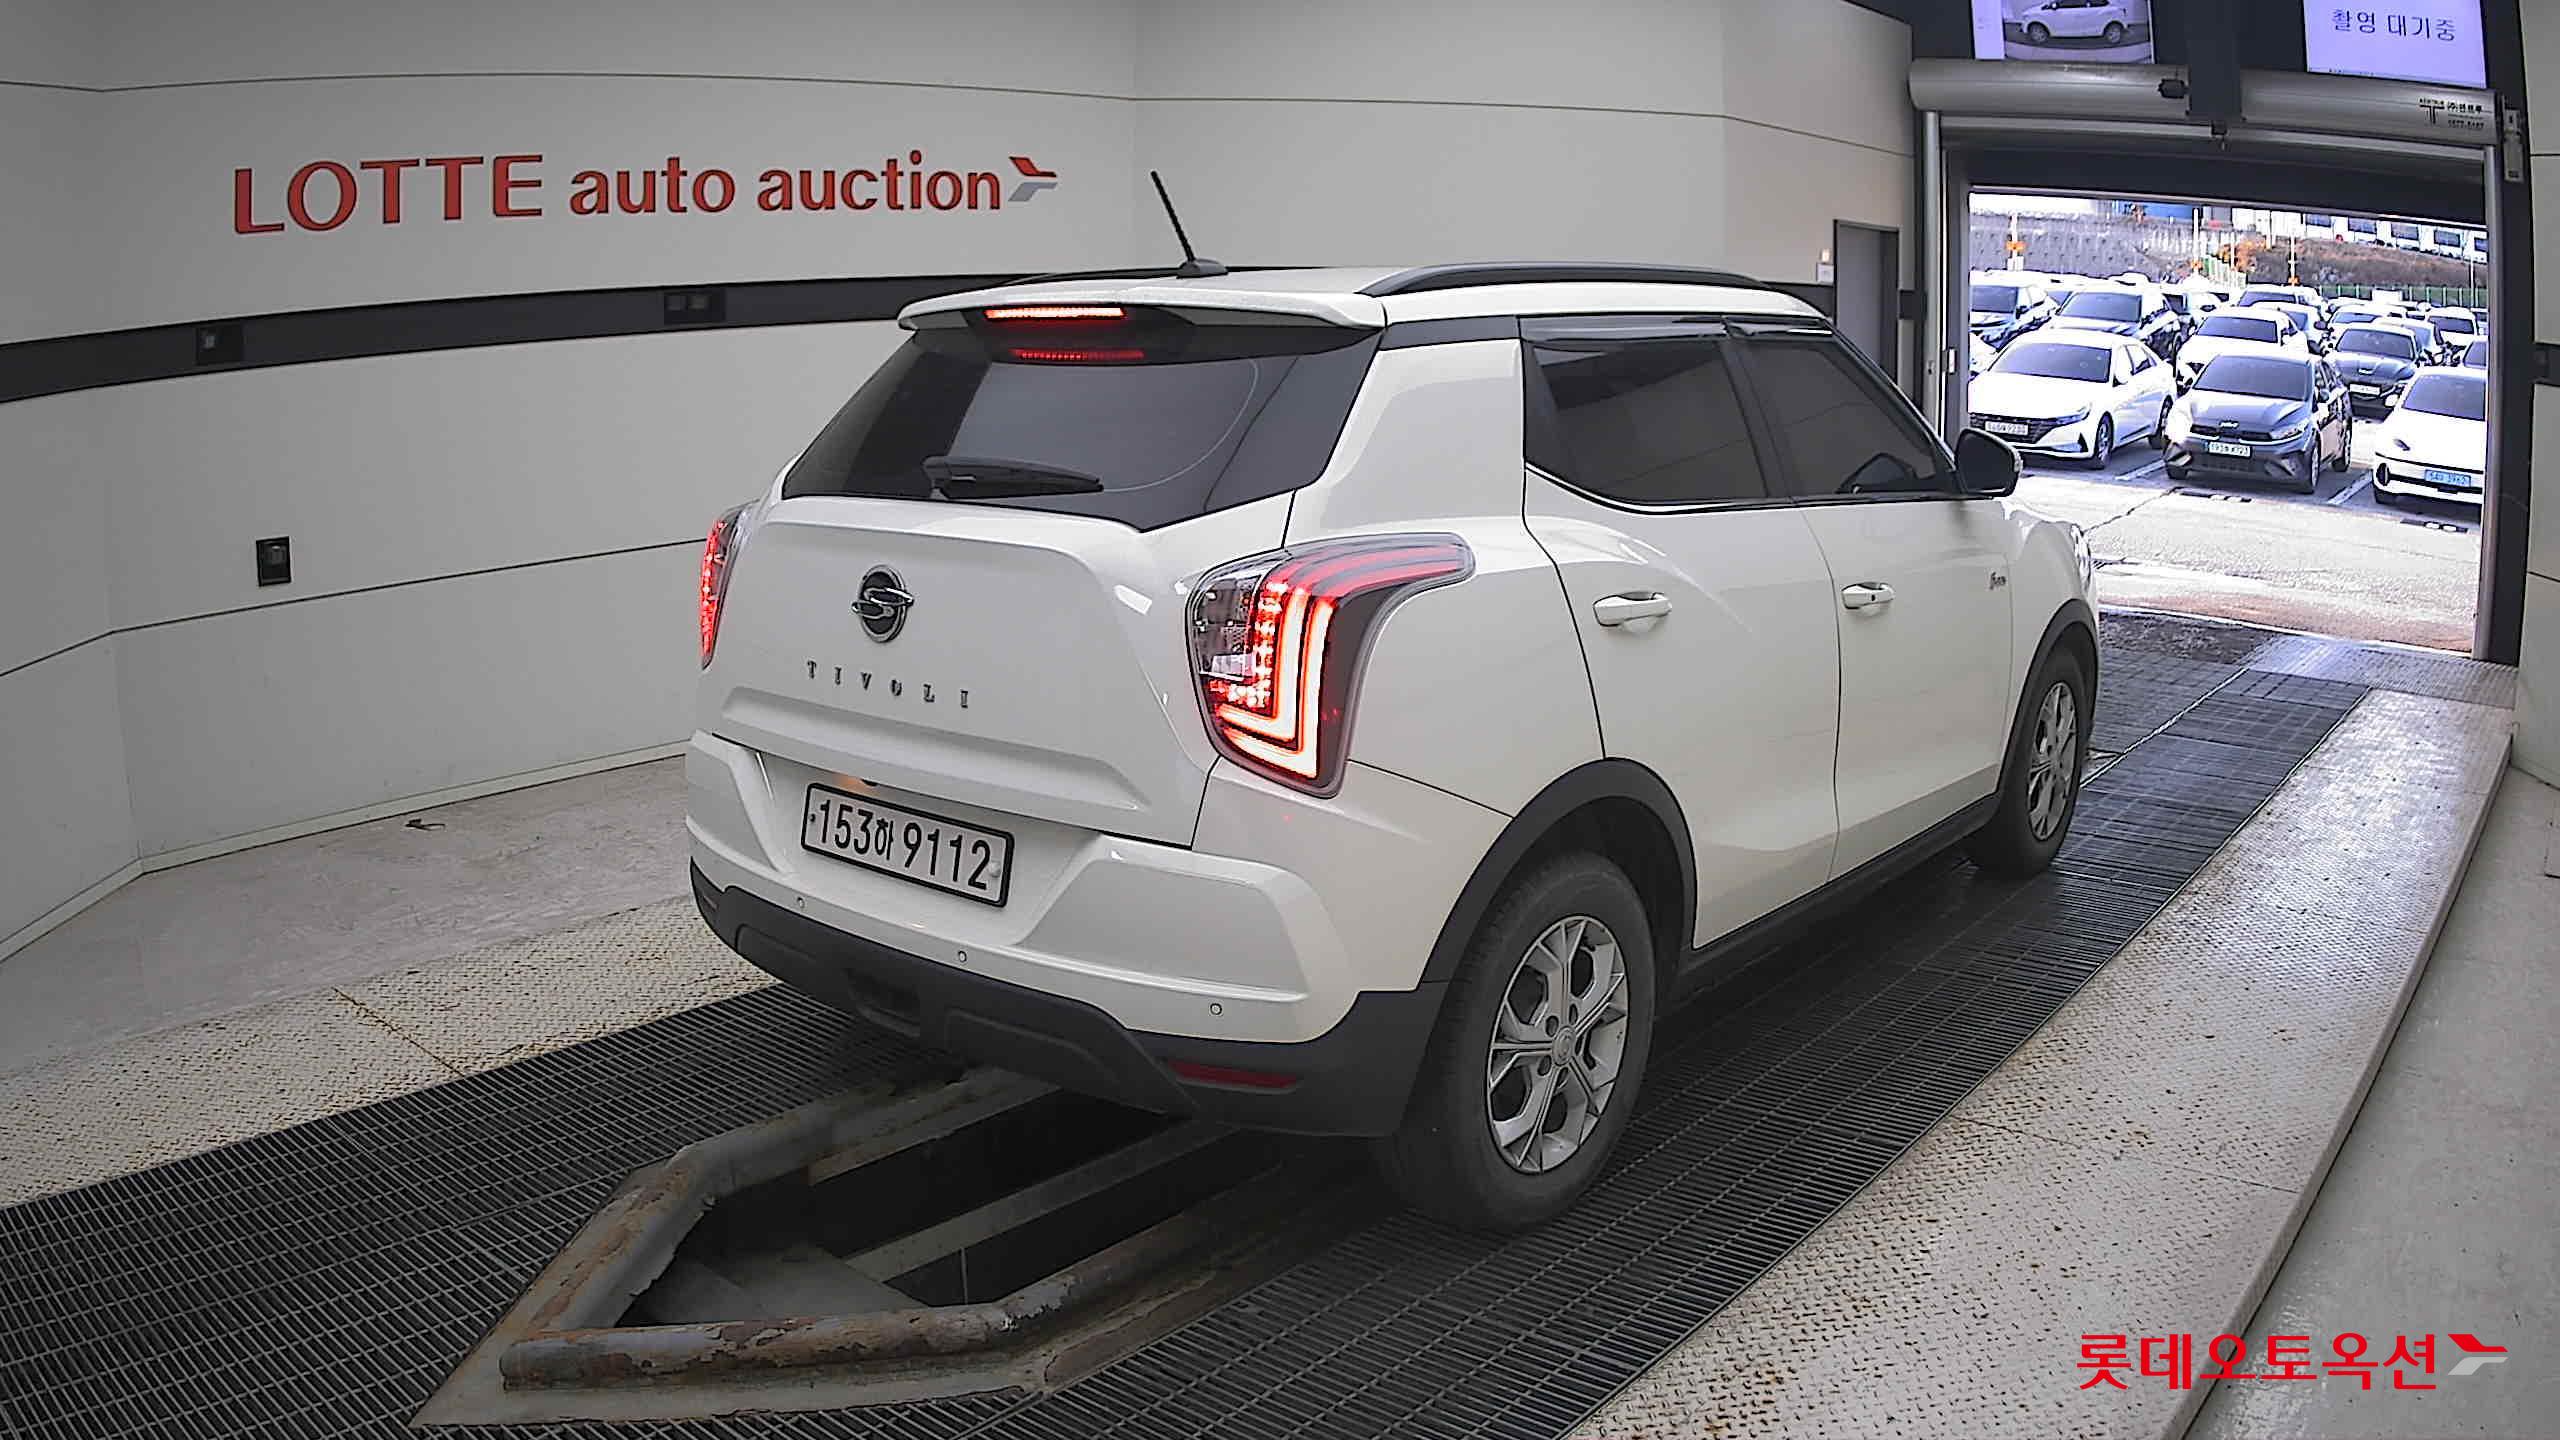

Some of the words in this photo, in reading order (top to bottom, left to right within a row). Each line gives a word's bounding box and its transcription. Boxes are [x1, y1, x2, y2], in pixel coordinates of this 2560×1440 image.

[2332, 9, 2376, 34] 촬영
[2387, 14, 2456, 42] 대기중
[234, 154, 543, 234] LOTTE
[569, 156, 736, 216] auto
[757, 149, 1002, 212] auction
[807, 660, 970, 709] TIVOLI
[903, 822, 991, 891] 9112
